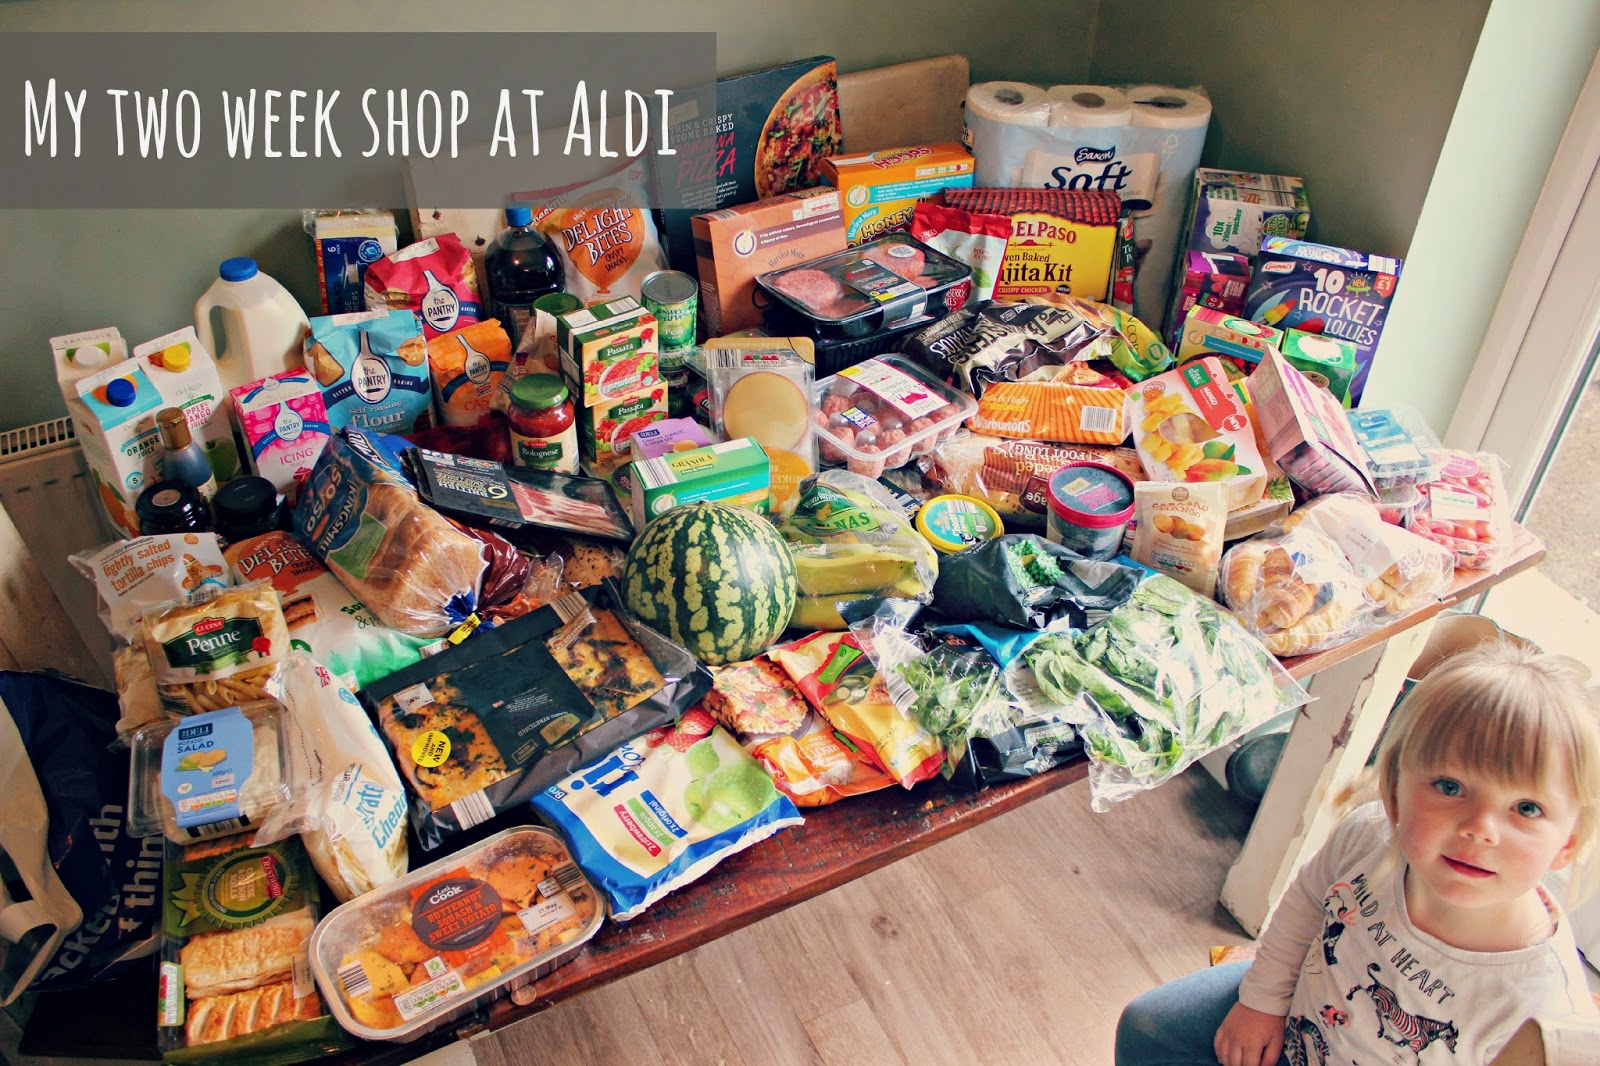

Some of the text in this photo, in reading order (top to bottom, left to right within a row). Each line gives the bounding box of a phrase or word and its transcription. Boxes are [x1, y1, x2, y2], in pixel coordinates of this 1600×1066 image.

[702, 113, 733, 127] CRISPY
[670, 122, 734, 145] STONE BAKED
[1077, 147, 1113, 163] Saxon
[675, 147, 737, 189] PIZZA
[1044, 161, 1133, 191] Soft
[562, 194, 633, 252] DELIGHT
[861, 207, 913, 237] HONEY
[585, 222, 633, 266] BITES
[1004, 253, 1021, 263] ven
[1023, 251, 1049, 263] Baked
[1043, 263, 1073, 282] Kit
[1313, 267, 1345, 295] 10
[1377, 279, 1391, 291] £1
[434, 296, 445, 305] the
[1299, 288, 1385, 327] ROCKET
[428, 304, 455, 317] PANTRY
[1324, 317, 1378, 346] LOLLIES
[606, 343, 634, 356] Passata
[469, 365, 487, 376] PANTRY
[358, 375, 387, 388] PANTRY
[1202, 386, 1217, 406] MANGO
[187, 408, 210, 423] ANGO
[351, 409, 405, 428] flour
[618, 403, 644, 415] Passata
[279, 421, 300, 434] PANTRY
[974, 418, 1031, 433] Warburtons
[1227, 415, 1242, 430] NEW
[127, 434, 160, 457] ORANGE
[137, 446, 156, 460] JUICE
[522, 448, 559, 459] Bolognese
[1016, 443, 1085, 460] FOOT LONG
[280, 447, 314, 465] ICING
[671, 455, 713, 468] GRANOLA
[1015, 461, 1056, 477] eeded
[321, 479, 356, 553] KINGSMILL
[103, 539, 171, 577] lightly salted
[111, 566, 145, 592] tortilla
[146, 553, 174, 573] chips
[186, 629, 242, 656] Penne
[177, 740, 214, 753] SALAD
[427, 747, 437, 758] AND
[433, 740, 446, 764] NEW
[619, 810, 650, 845] strawberry
[639, 811, 656, 831] apple
[261, 856, 283, 898] CRESTWOOD
[429, 886, 462, 905] Cook
[427, 891, 483, 922] BUTTERNUT
[437, 901, 483, 928] SQUASH &
[428, 918, 463, 942] SWEET
[464, 902, 497, 926] POTATO
[1351, 873, 1455, 1005] WILD AT HEART
